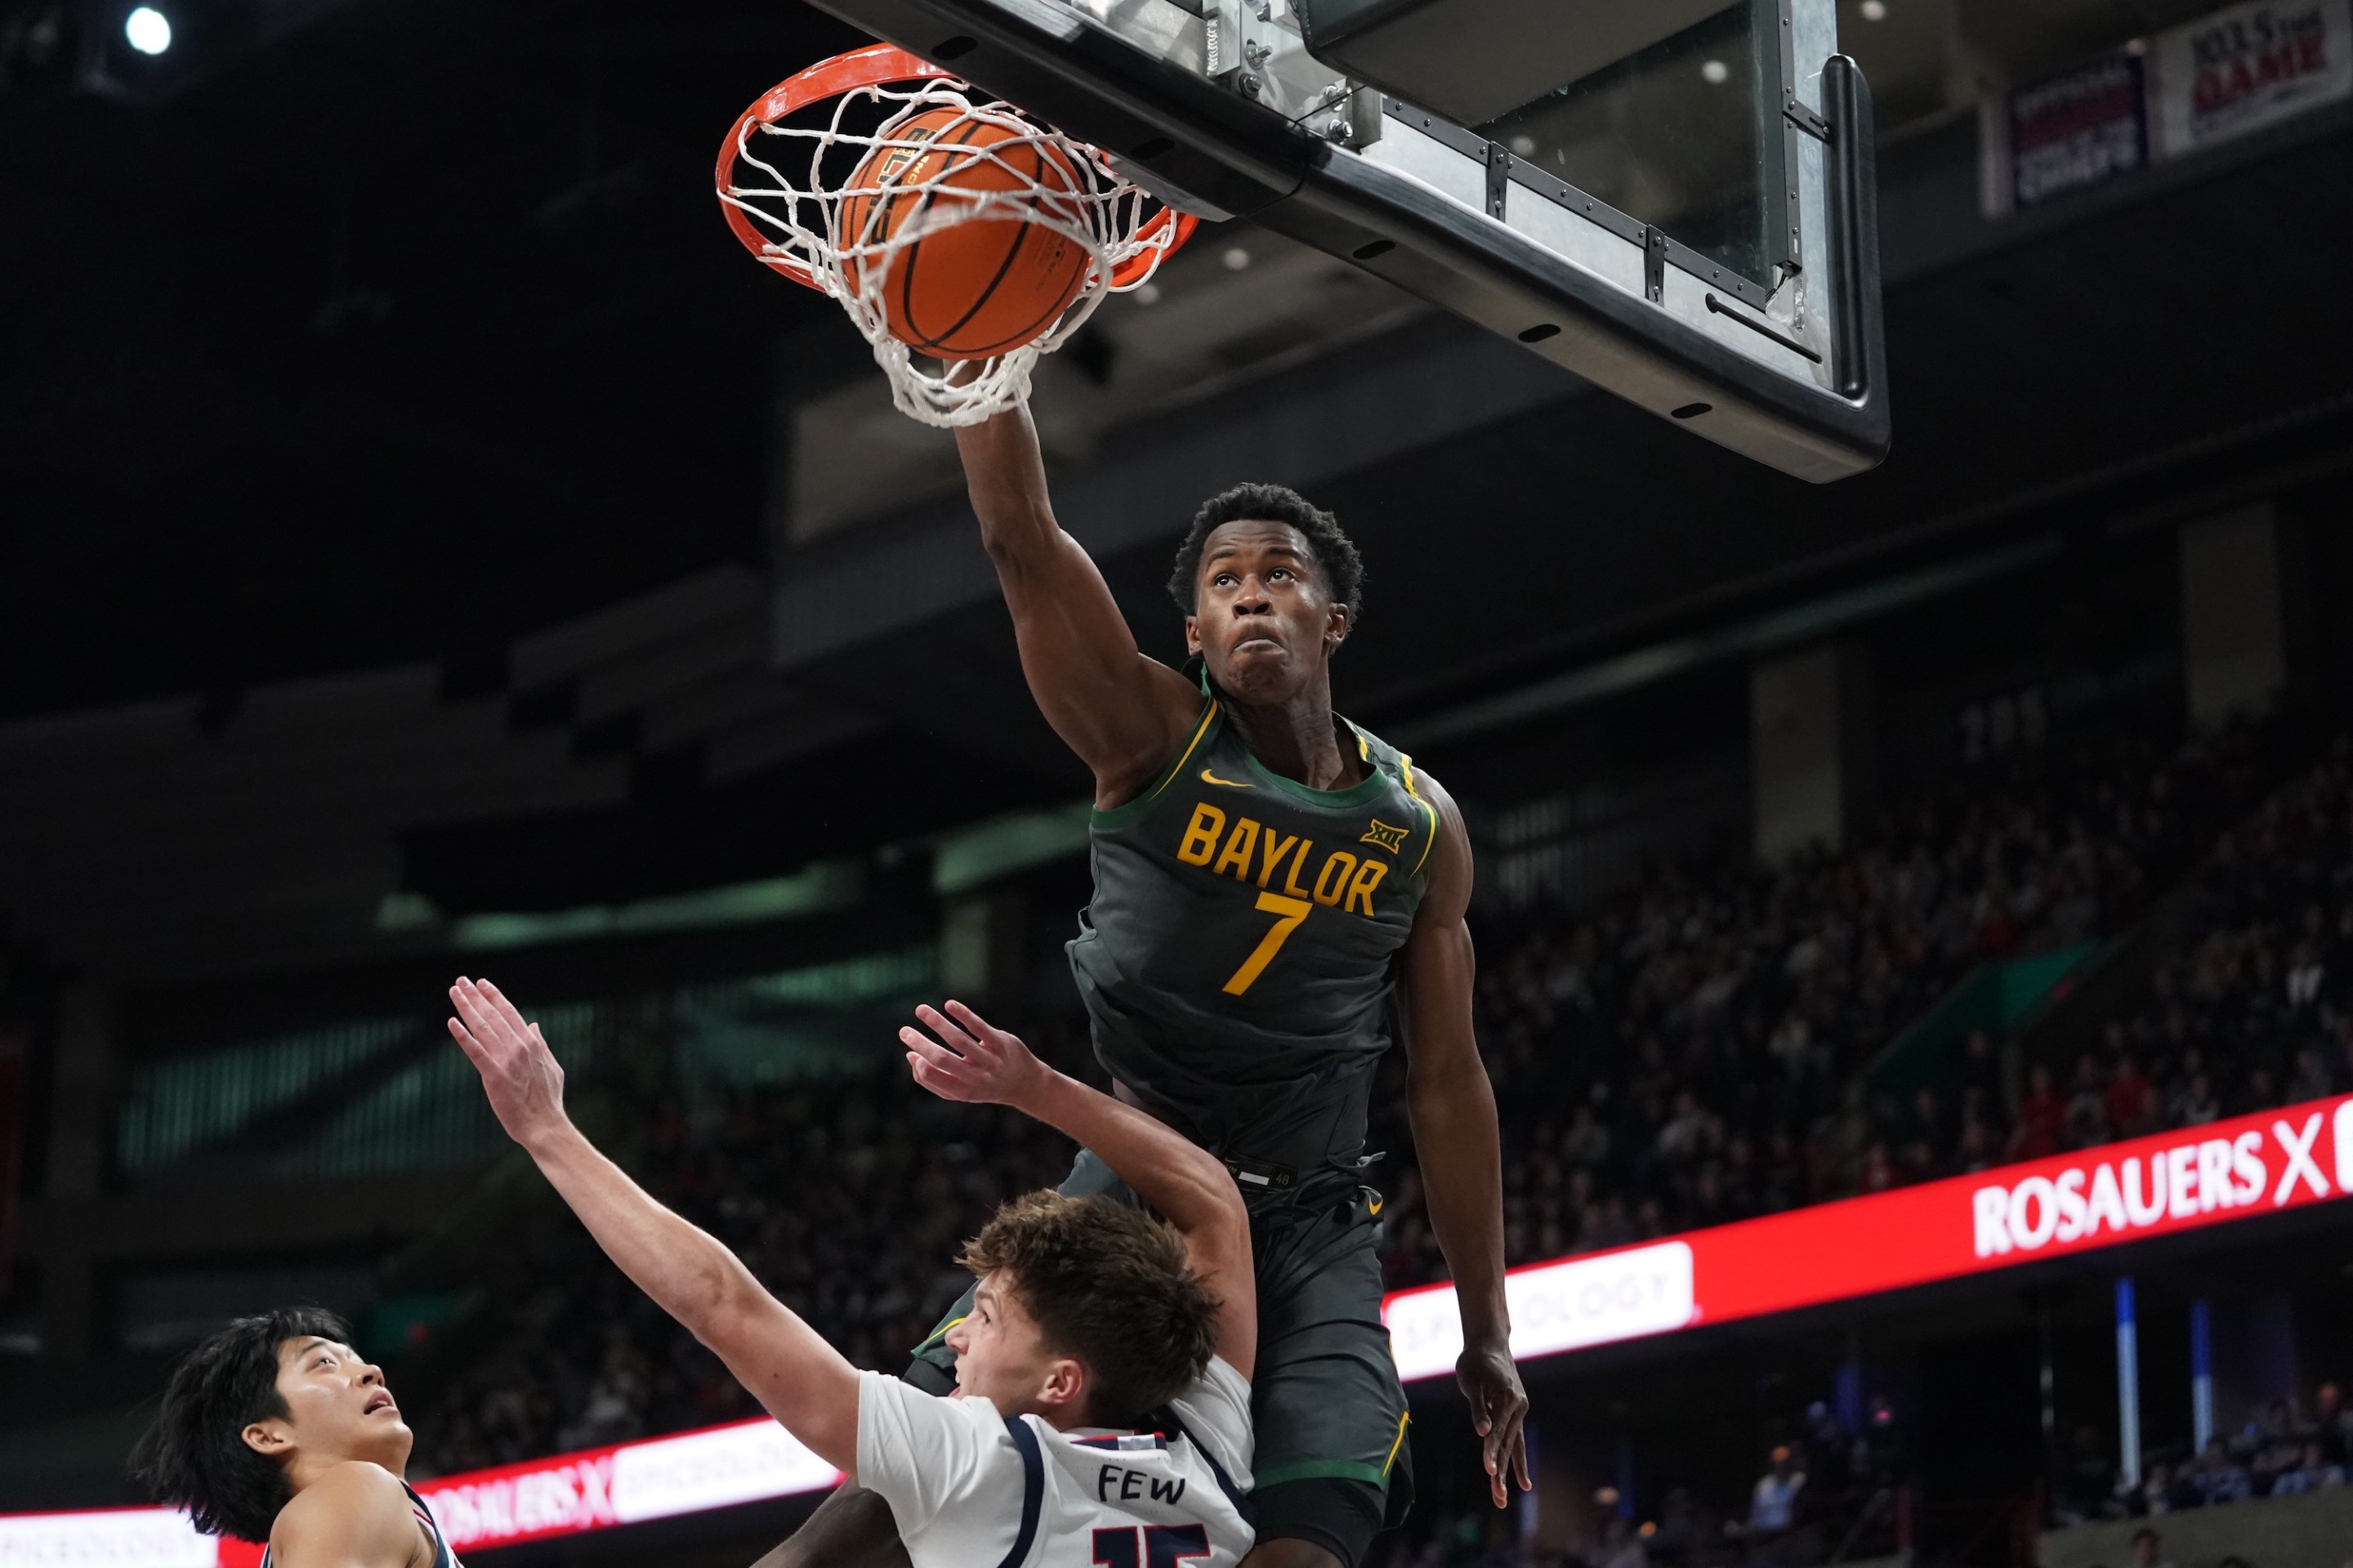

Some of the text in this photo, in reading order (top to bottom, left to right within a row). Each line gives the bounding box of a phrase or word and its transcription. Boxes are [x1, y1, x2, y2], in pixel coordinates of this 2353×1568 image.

[1176, 802, 1389, 917] BAYLOR
[1221, 891, 1313, 996] 7
[1973, 1112, 2331, 1259] ROSAUERS X
[1403, 1271, 1671, 1354] SPOLOGY
[1098, 1463, 1185, 1505] FEW
